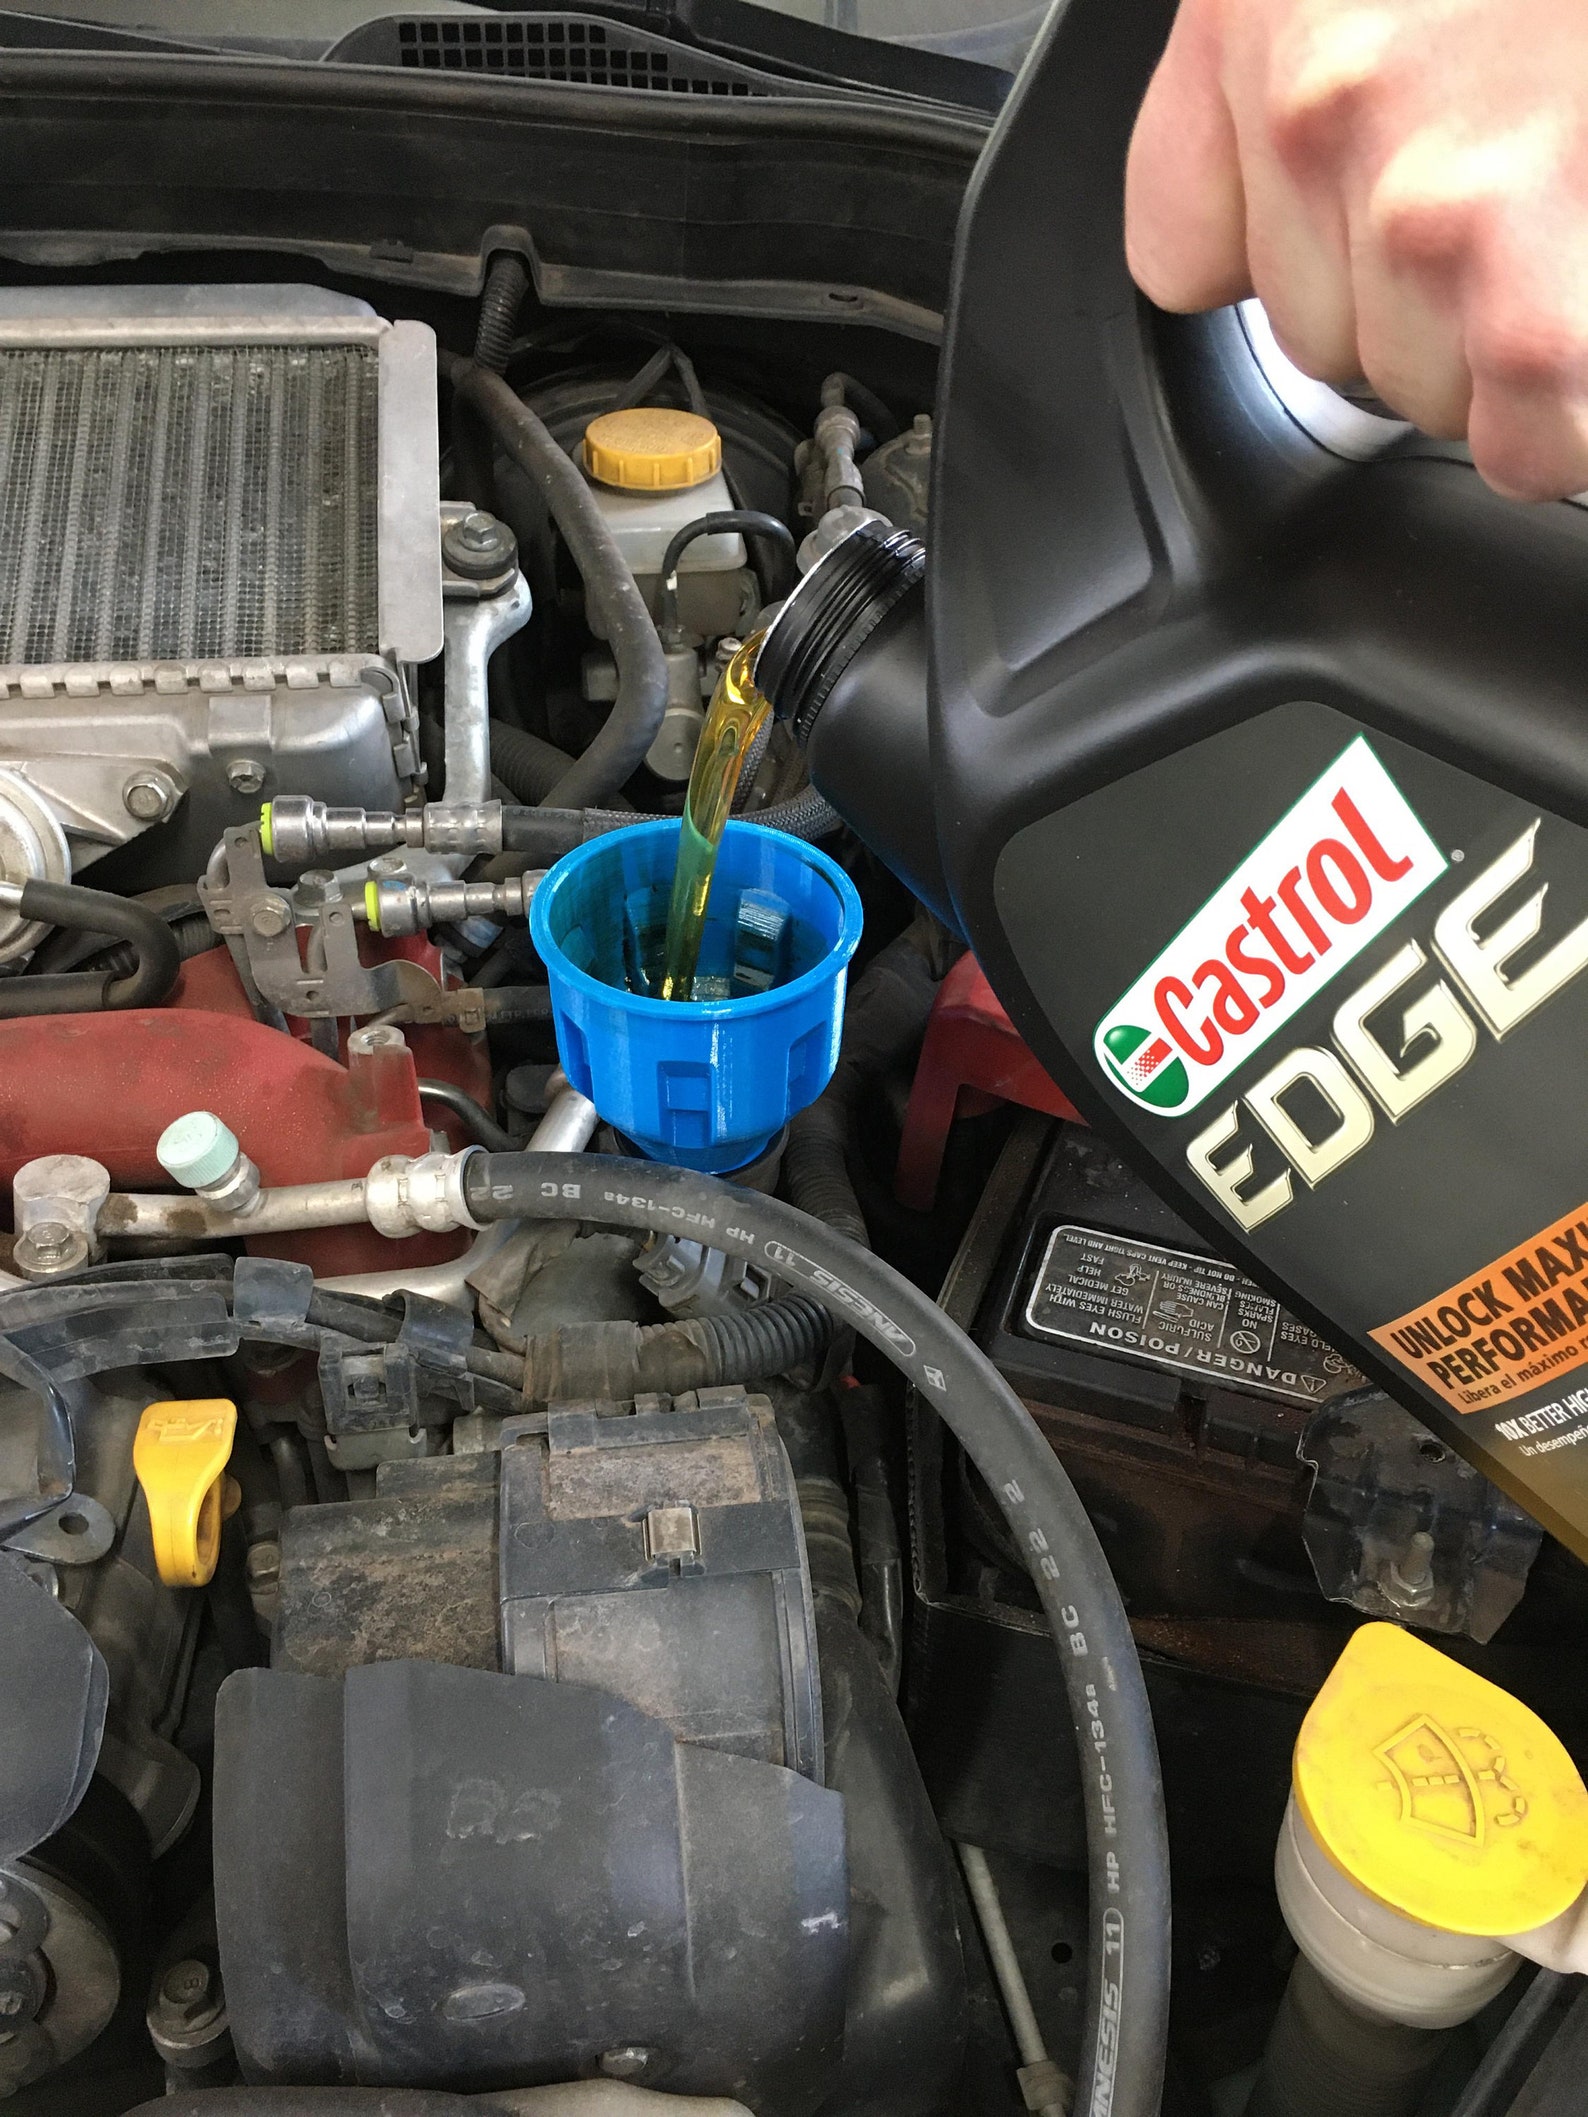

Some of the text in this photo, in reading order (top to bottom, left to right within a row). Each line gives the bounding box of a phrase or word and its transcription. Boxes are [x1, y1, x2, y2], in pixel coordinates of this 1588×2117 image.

[1154, 786, 1414, 1067] Castrol
[1186, 817, 1588, 1234] EDGE
[540, 1181, 581, 1199] BC
[604, 1191, 715, 1229] HFC-134a
[726, 1226, 755, 1245] HP
[1088, 1240, 1103, 1249] AND
[774, 1246, 797, 1267] 11
[1081, 1253, 1104, 1264] FAST
[1104, 1245, 1124, 1254] TIGHT
[1127, 1250, 1146, 1259] CAPS
[1148, 1255, 1166, 1264] VENT
[1168, 1261, 1187, 1270] KEEP
[1078, 1265, 1101, 1276] HELP
[1207, 1270, 1222, 1278] NOT
[1069, 1274, 1129, 1295] GET MEDICAL
[1161, 1273, 1194, 1289] INJURY
[1163, 1281, 1175, 1289] OR
[1195, 1281, 1230, 1296] SEVERE
[1046, 1284, 1143, 1314] WATER IMMEDIATELY
[1176, 1293, 1224, 1310] CAN CAUSE
[1235, 1291, 1276, 1308] SMOKING
[1050, 1294, 1141, 1323] FLUSH EYES WITH
[1238, 1308, 1273, 1323] SPARKS
[1189, 1319, 1214, 1331] ACID
[1242, 1319, 1257, 1329] NO
[1390, 1279, 1514, 1359] UNLOCK
[1090, 1322, 1179, 1354] POISON
[1281, 1331, 1307, 1344] EYES
[1427, 1275, 1588, 1390] PERFORMA
[1197, 1349, 1296, 1384] DANGER
[1457, 1383, 1502, 1405] Libera
[1501, 1373, 1517, 1389] el
[1517, 1345, 1579, 1382] máximo
[1494, 1418, 1530, 1440] 10X
[1518, 1402, 1573, 1434] BETTER
[1518, 1445, 1538, 1456] Un
[1028, 1527, 1061, 1580] 22
[1061, 1604, 1089, 1657] BC
[1086, 1683, 1118, 1837] HFC-134a
[1107, 1850, 1121, 1893] HP
[1106, 1922, 1121, 1954] 11
